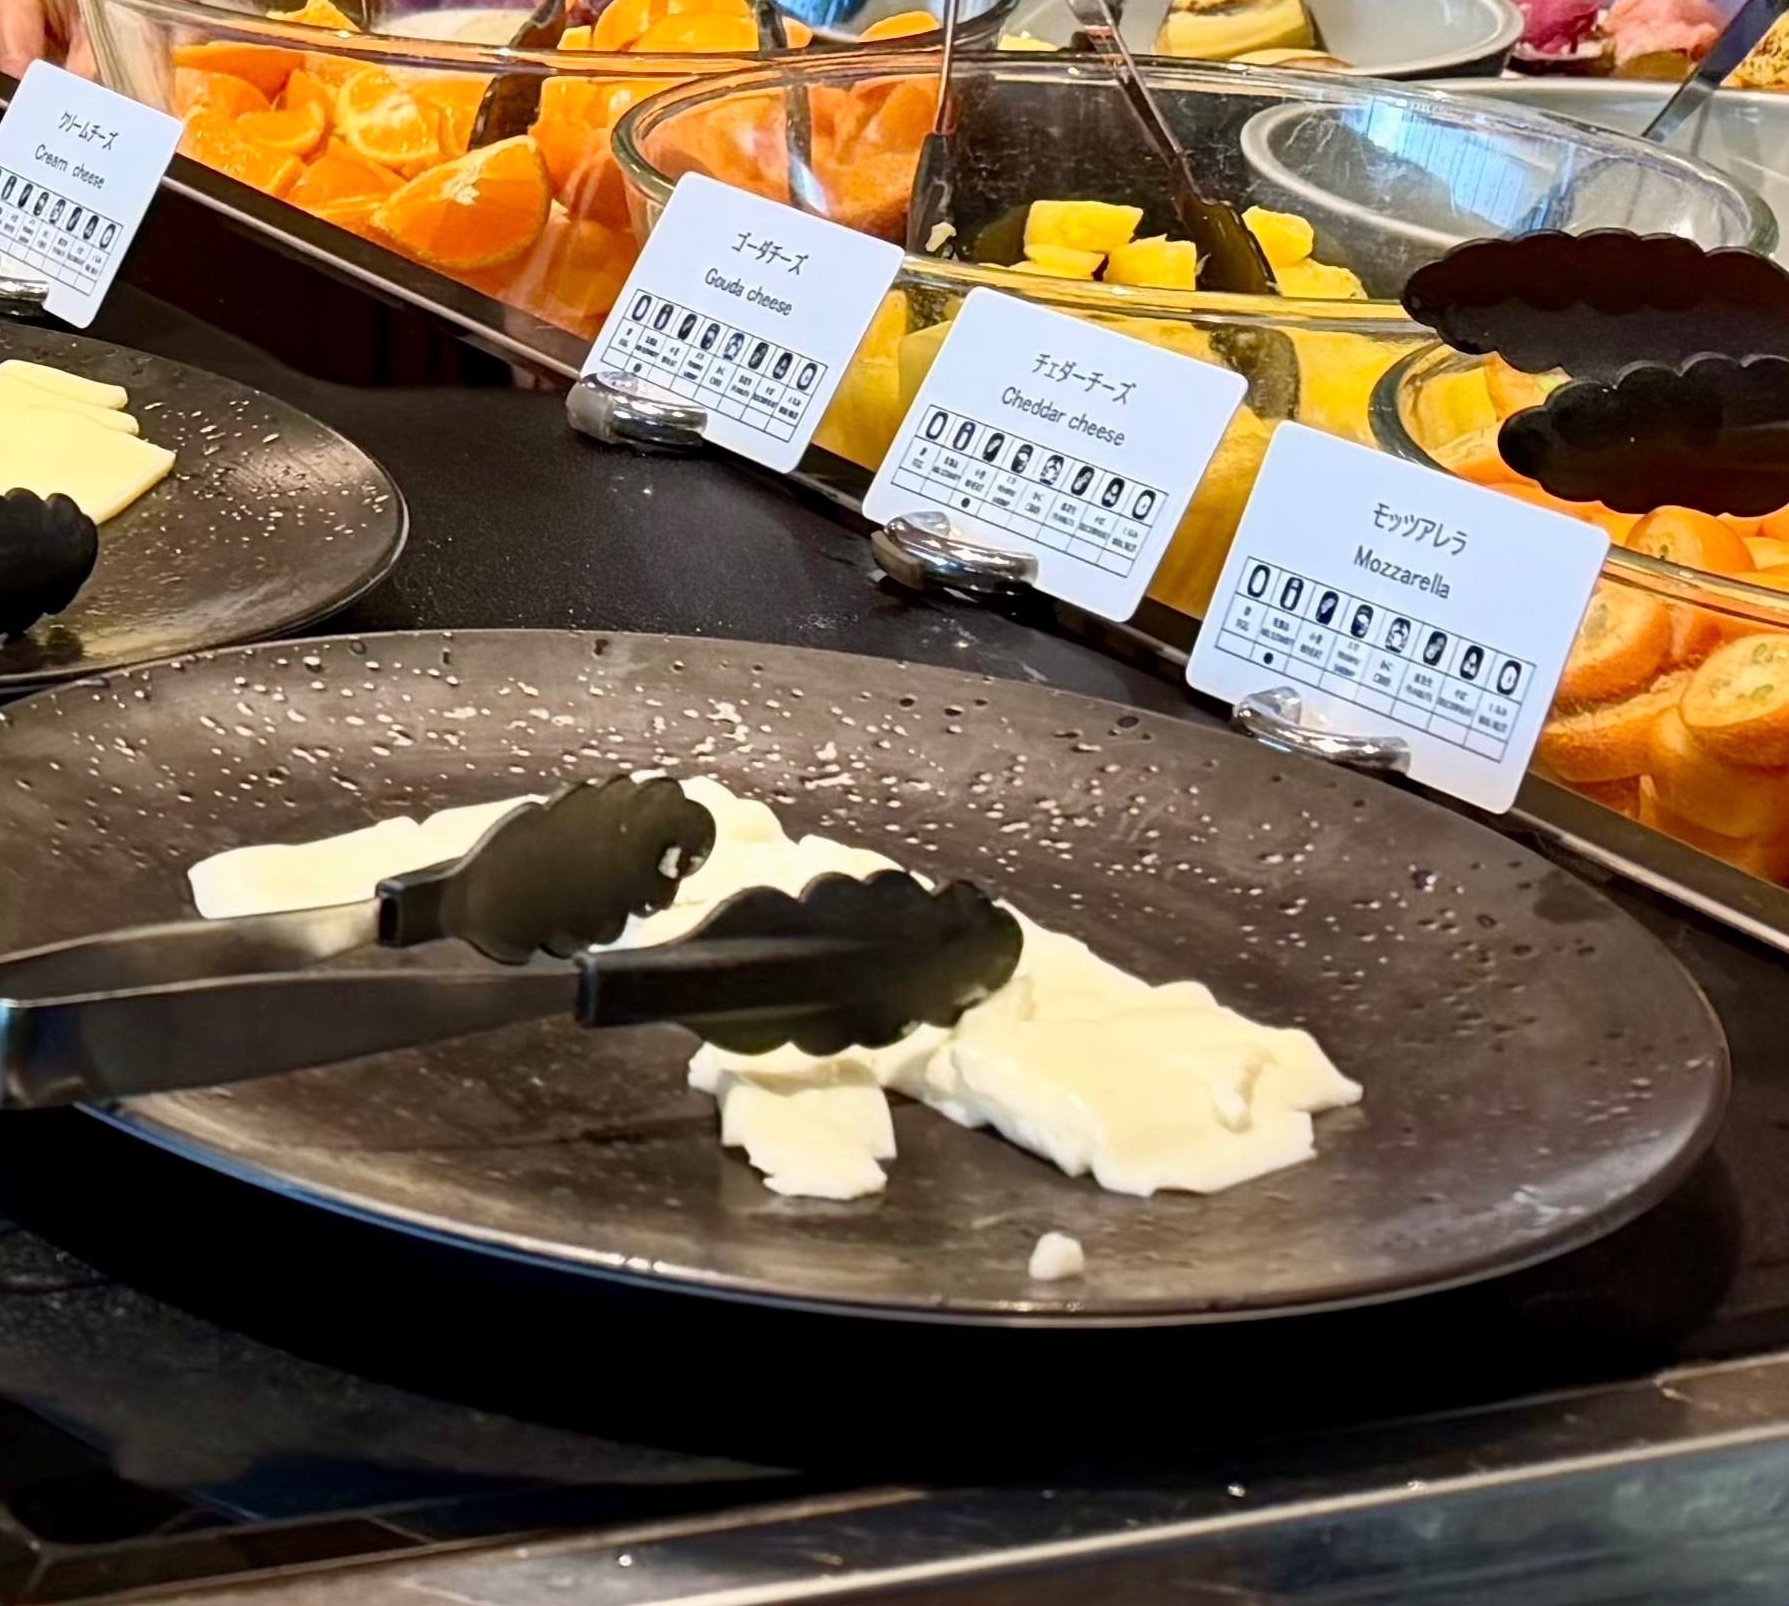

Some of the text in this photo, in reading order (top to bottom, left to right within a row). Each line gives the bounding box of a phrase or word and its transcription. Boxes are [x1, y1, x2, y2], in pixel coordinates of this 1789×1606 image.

[58, 111, 119, 151] クリームチーズ
[35, 144, 105, 190] Cream cheese
[731, 232, 809, 275] ゴーダチーズ
[704, 268, 794, 316] Gouda cheese
[1031, 353, 1137, 406] チェダーチーズ
[1001, 386, 1125, 447] Cheddar cheese
[1353, 544, 1451, 599] Mozzarella
